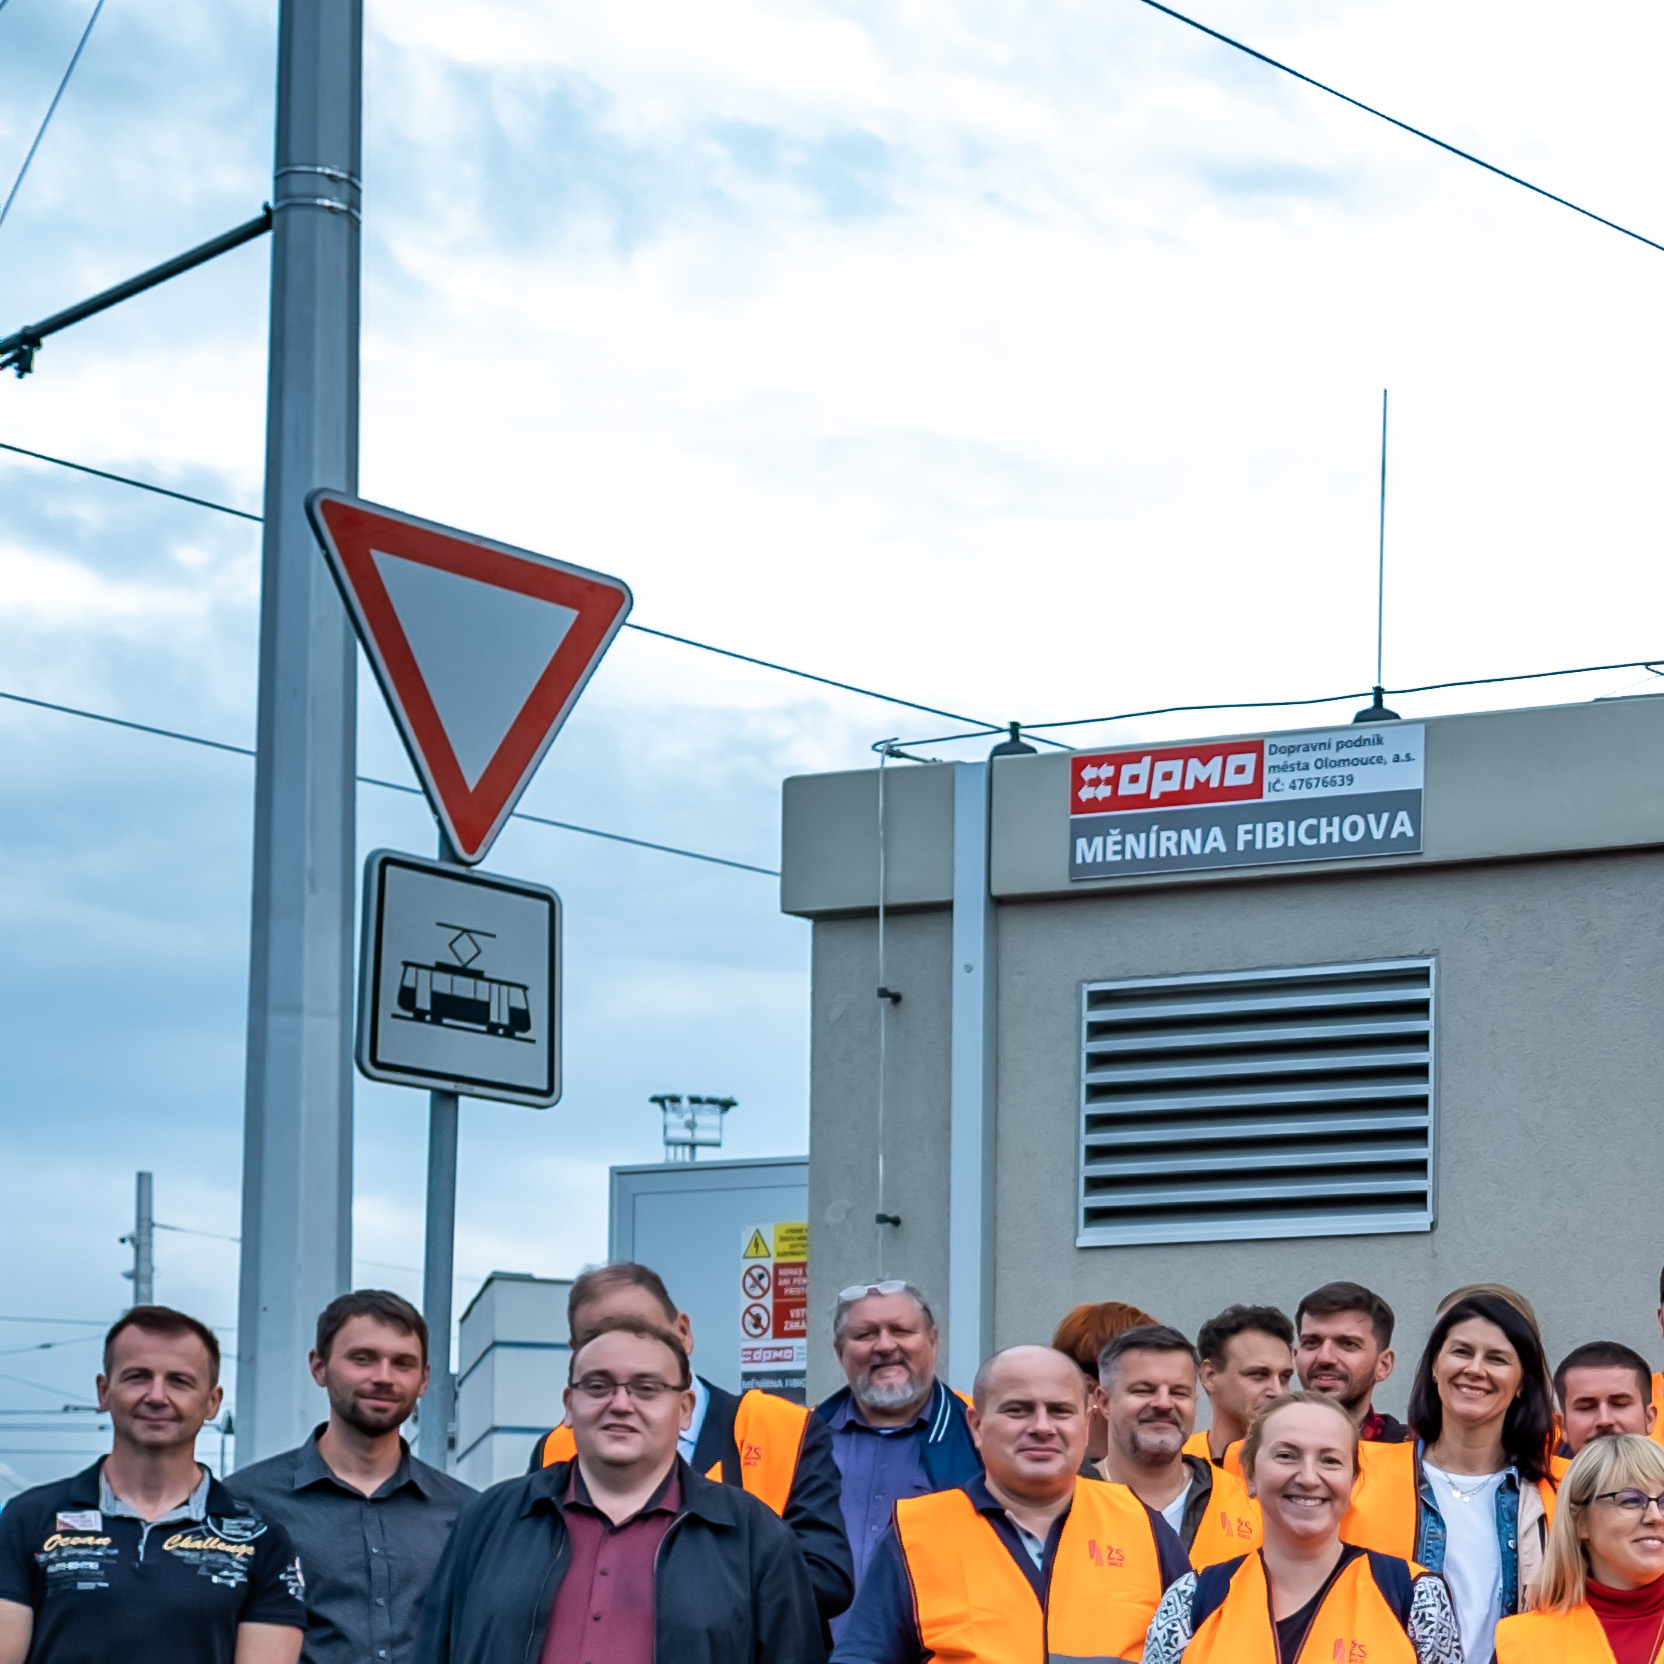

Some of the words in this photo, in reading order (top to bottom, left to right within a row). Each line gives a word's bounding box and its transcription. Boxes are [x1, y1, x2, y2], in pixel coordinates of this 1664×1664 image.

[1268, 738, 1331, 757] Dopravní
[1335, 734, 1384, 753] podnik
[1268, 760, 1310, 774] města
[1314, 754, 1388, 770] Olomouce,
[1392, 752, 1416, 763] a.s.
[1268, 778, 1284, 793] IČ:
[1288, 774, 1354, 791] 47676639
[1075, 824, 1227, 864] MĚNÍRNA
[1236, 810, 1415, 851] FIBICHOVA
